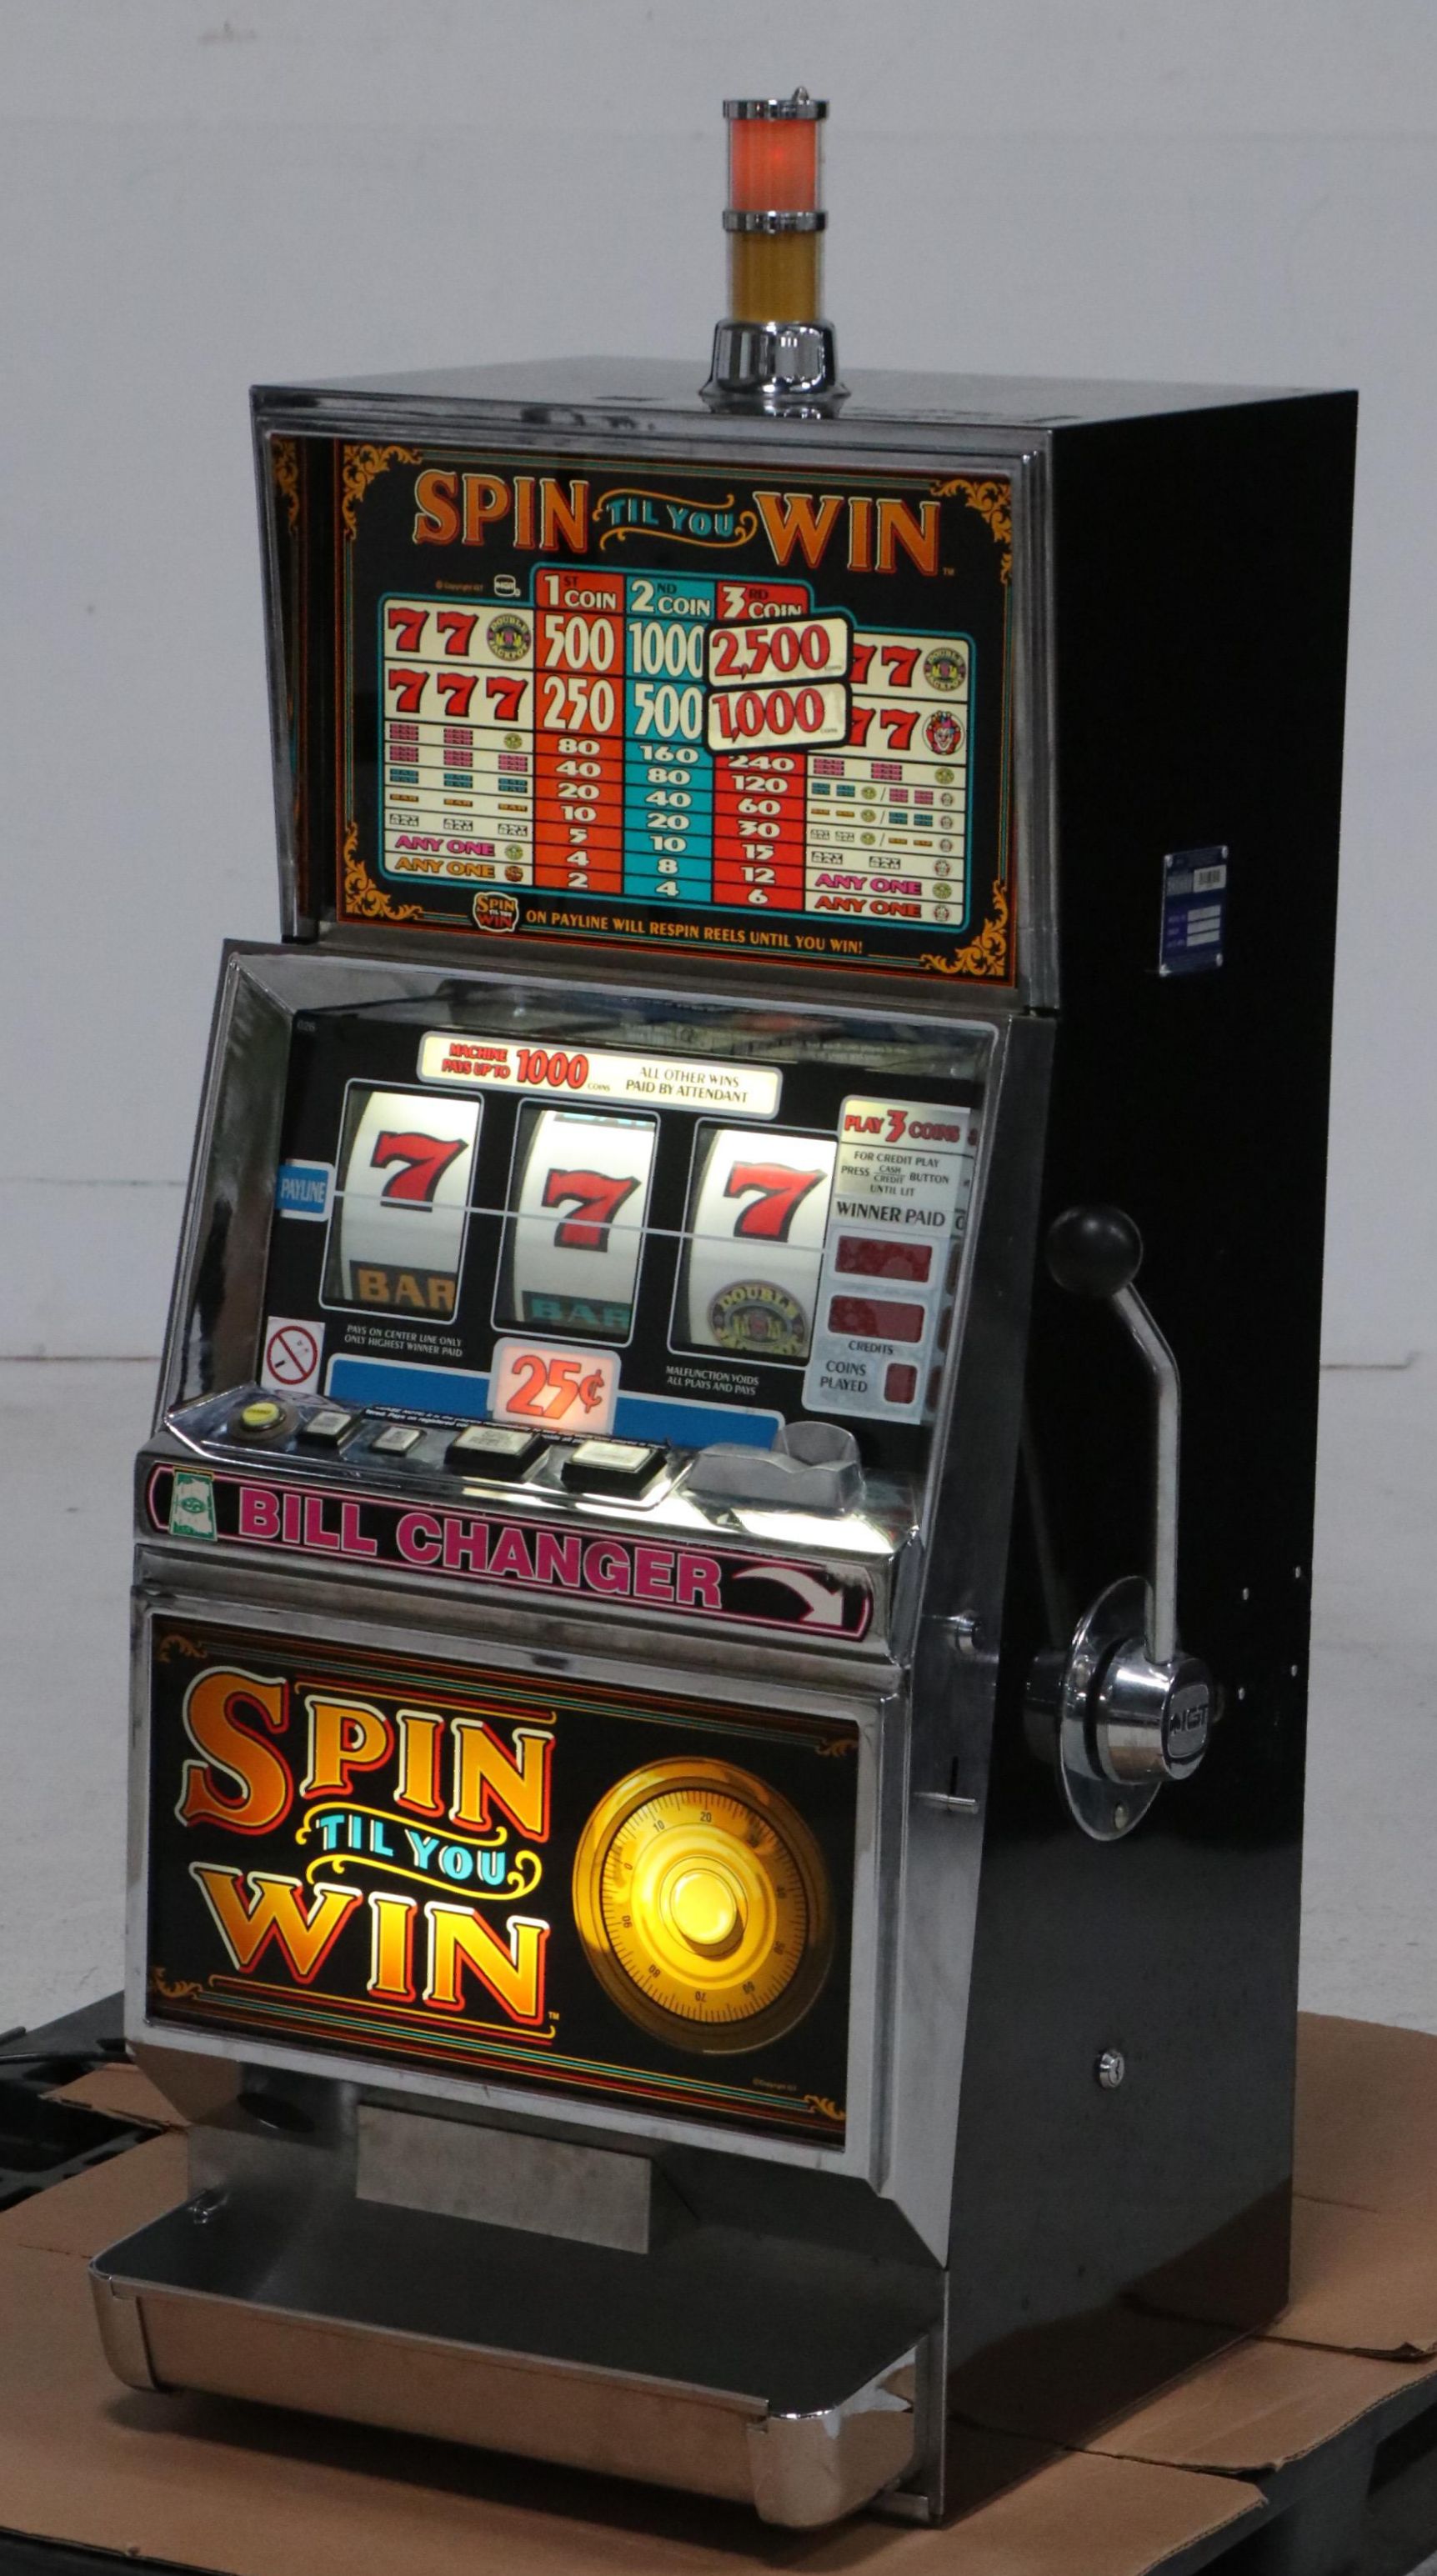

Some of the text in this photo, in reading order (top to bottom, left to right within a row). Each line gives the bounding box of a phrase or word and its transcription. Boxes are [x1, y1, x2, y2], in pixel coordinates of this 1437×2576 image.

[413, 469, 589, 553] SPIN
[607, 498, 659, 525] TIL
[667, 506, 735, 538] YOU
[753, 492, 940, 577] WIN
[564, 589, 616, 610] COIN
[658, 597, 710, 616] COIN
[544, 614, 614, 671] 500
[629, 621, 704, 678] 1000
[712, 624, 830, 680] 2,500
[543, 676, 614, 733] 250
[634, 682, 703, 739] 500
[712, 688, 825, 743] 1,000
[558, 738, 600, 756] 80
[639, 744, 698, 764] 160
[555, 761, 602, 778] 40
[729, 754, 796, 773] 240
[647, 768, 691, 785] 80
[732, 775, 788, 794] 120
[558, 783, 600, 800] 20
[645, 790, 693, 808] 40
[561, 805, 597, 823] 10
[738, 798, 781, 816] 60
[647, 813, 690, 830] 20
[738, 821, 781, 838] 30
[569, 828, 588, 844] 5
[651, 835, 687, 853] 10
[395, 835, 495, 857] ANY ONE
[742, 844, 775, 861] 15
[395, 857, 495, 878] ANY ONE
[567, 851, 589, 868] 4
[657, 858, 678, 874] 8
[568, 873, 588, 888] 2
[740, 867, 776, 884] 12
[815, 873, 922, 896] ANY ONE
[655, 880, 678, 898] 4
[748, 889, 769, 905] 6
[477, 895, 515, 913] SPIN
[815, 896, 922, 918] ANY ONE
[478, 915, 513, 928] WIN
[526, 910, 863, 954] ON PAYLINE WILL RESPIN REELS UNTIL YOU WIN!
[449, 1043, 508, 1063] MACHINE
[442, 1058, 510, 1079] PAYS UP TO
[517, 1048, 588, 1089] 1000
[640, 1067, 739, 1088] ALL OTHER WINS
[626, 1079, 748, 1103] PAID BY ATTENDANT
[844, 1109, 960, 1143] PLAY 3 COINS
[854, 1151, 940, 1168] FOR CREDIT PLAY
[879, 1164, 901, 1174] CASH
[370, 1130, 469, 1213] 7
[840, 1165, 949, 1184] PRESS BUTTON
[874, 1175, 904, 1184] CREDIT
[281, 1178, 327, 1203] PAYLINE
[869, 1184, 915, 1197] UNTIL LIT
[541, 1168, 641, 1252] 7
[723, 1160, 828, 1243] 7
[836, 1201, 946, 1227] WINNER PAID
[358, 1268, 455, 1312] BAR
[347, 1324, 462, 1347] PAYS ON CENTER LINE ONLY
[344, 1334, 463, 1357] ONLY HIGHEST WINNER PAID
[848, 1340, 894, 1355] CREDITS
[666, 1366, 759, 1386] MALFUNCTION VOIDS
[825, 1360, 867, 1376] COINS
[506, 1354, 605, 1420] 25¢
[667, 1376, 756, 1395] ALL PLAYS AND PAYS
[819, 1376, 868, 1393] PLAYED
[238, 1486, 723, 1609] BILL CHANGER
[175, 1666, 555, 1843] SPIN
[653, 1819, 666, 1833] 10
[700, 1811, 712, 1823] 20
[316, 1814, 506, 1886] TIL YOU
[189, 1860, 550, 2026] WIN
